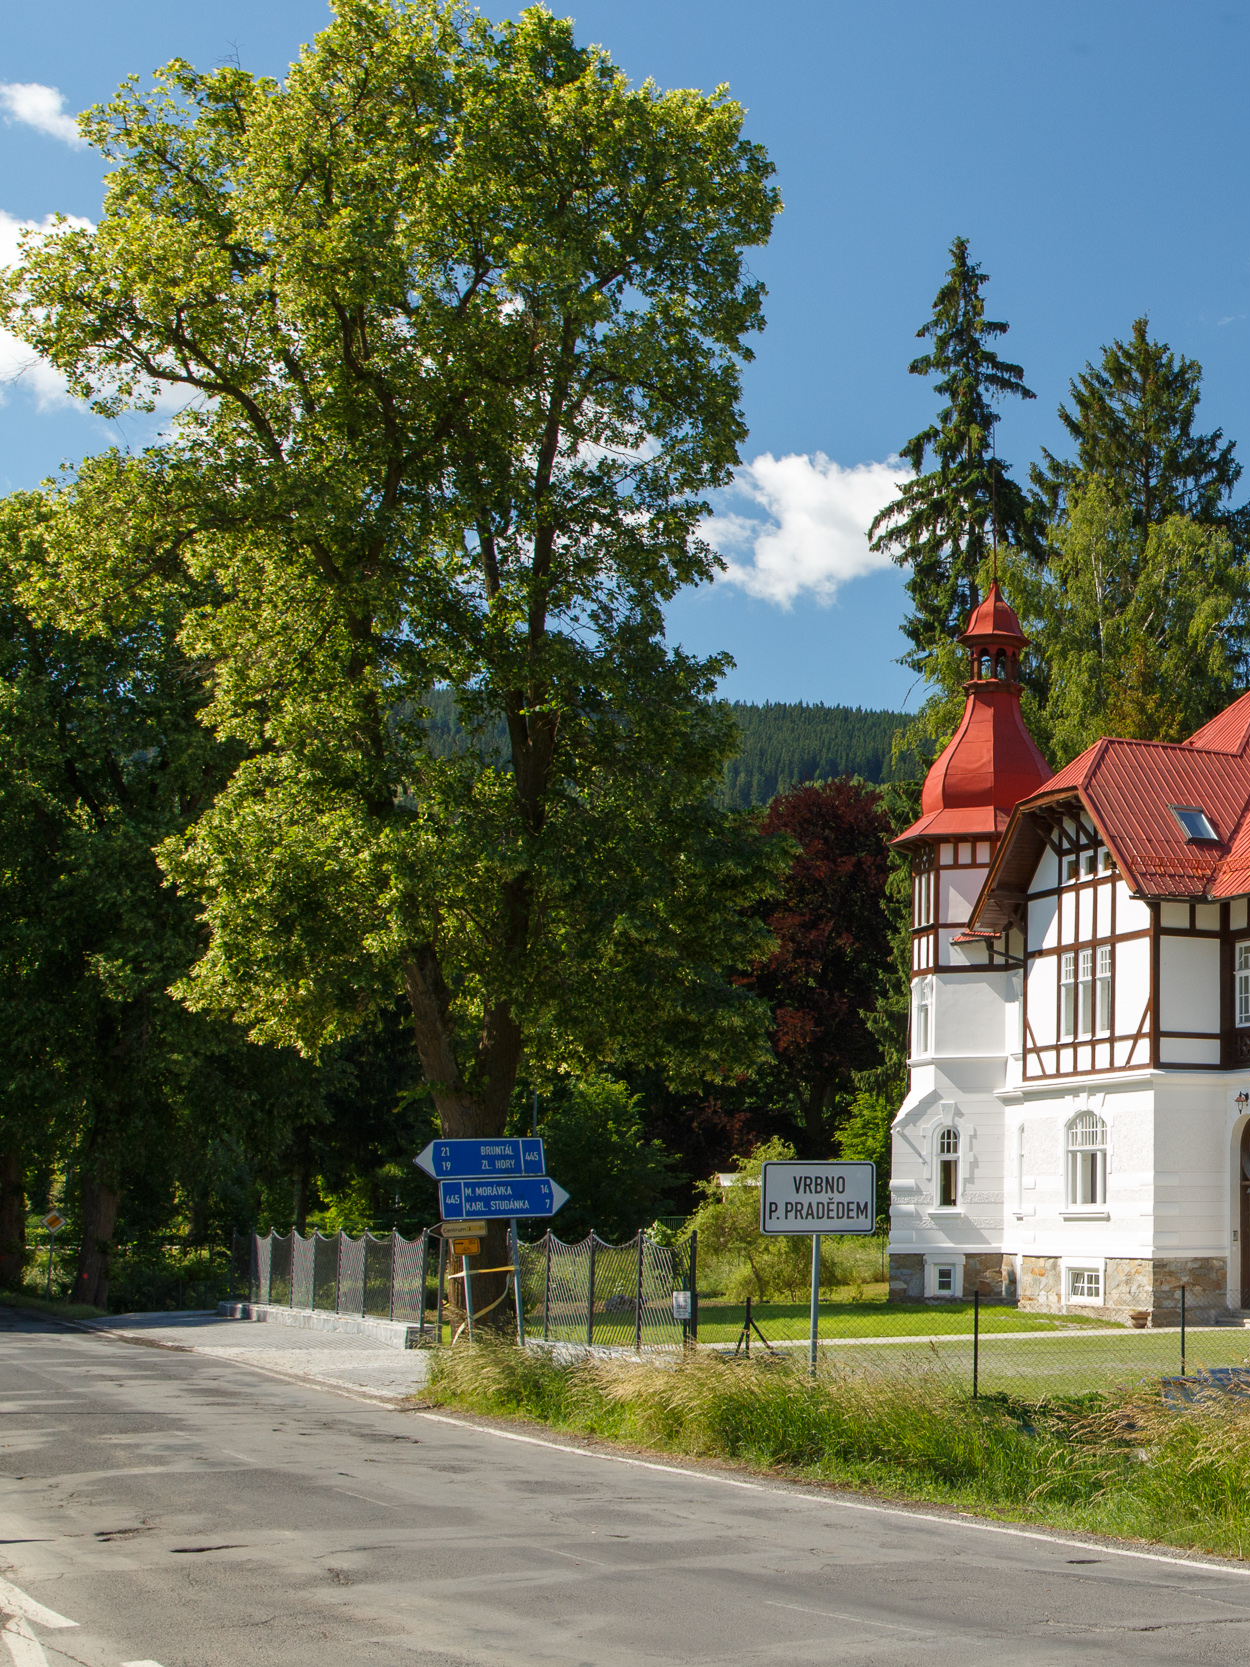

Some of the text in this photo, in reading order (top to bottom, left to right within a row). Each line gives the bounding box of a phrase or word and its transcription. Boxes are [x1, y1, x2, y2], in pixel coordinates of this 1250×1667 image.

[441, 1147, 450, 1156] 21
[480, 1144, 514, 1155] BRUNTÁL
[525, 1152, 539, 1161] 445
[442, 1162, 451, 1170] 19
[481, 1160, 515, 1169] ZL. HORY
[540, 1185, 549, 1194] 14
[793, 1176, 846, 1194] VRBNO
[465, 1184, 512, 1197] M. MORÁVKA
[445, 1195, 460, 1204] 445
[545, 1200, 550, 1208] 7
[465, 1198, 530, 1211] KARL. STUDÁNKA
[769, 1197, 868, 1220] P. PRADĚDEM
